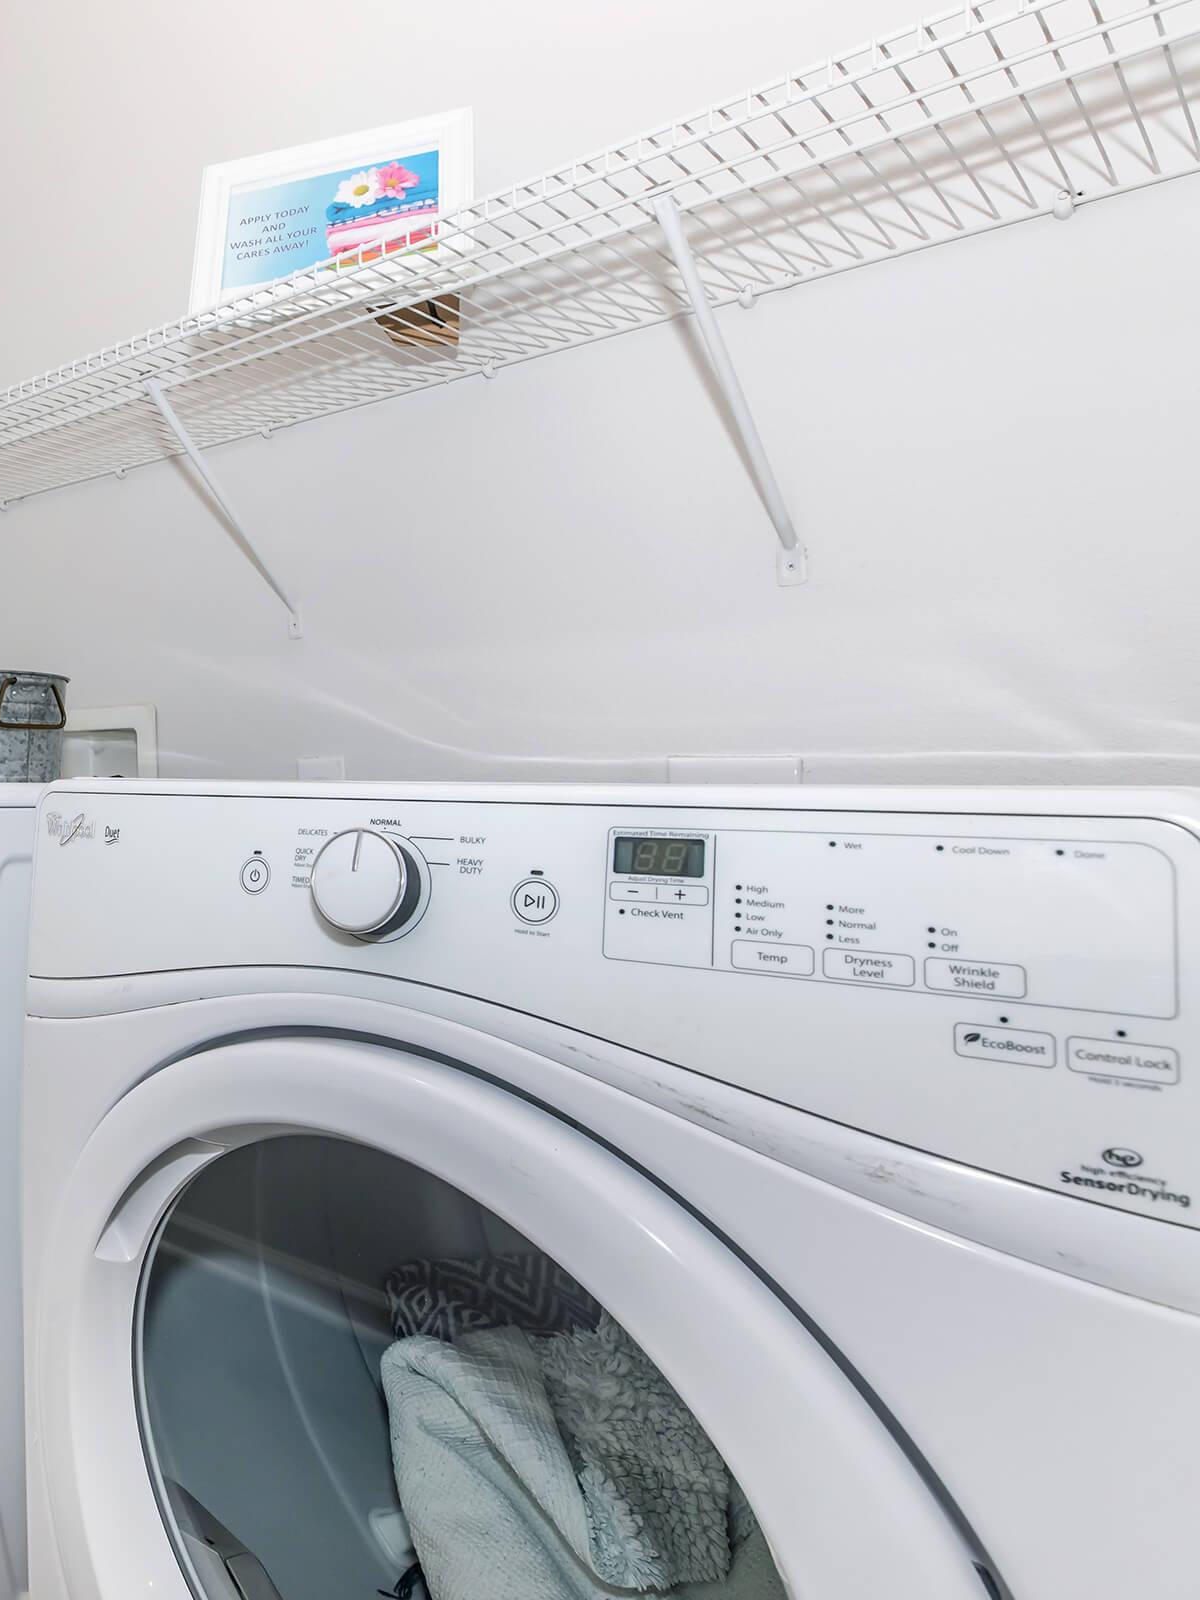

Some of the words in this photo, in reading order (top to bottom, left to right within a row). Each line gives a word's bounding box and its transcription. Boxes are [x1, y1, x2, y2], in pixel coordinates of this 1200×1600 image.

[240, 214, 271, 226] APPLY
[275, 205, 310, 220] TODAY
[262, 222, 286, 233] AND
[230, 238, 262, 250] WASH
[265, 234, 284, 244] ALL
[287, 226, 317, 239] YOUR
[236, 247, 270, 260] CARES
[273, 239, 309, 254] AWAY!
[369, 818, 402, 826] NORMAL
[104, 825, 120, 838] Duet
[298, 828, 329, 836] DELICATES
[613, 829, 648, 837] Estimated
[669, 831, 710, 840] Remaining
[460, 836, 486, 844] BULKY
[843, 841, 863, 850] Wet
[295, 847, 314, 855] QUICK
[951, 845, 976, 855] Cool
[978, 846, 1011, 855] Down
[457, 858, 484, 866] HEAVY
[459, 866, 483, 874] DUTY
[746, 885, 769, 894] High
[746, 898, 785, 909] Medium
[630, 907, 660, 918] Check
[661, 909, 684, 920] Vent
[838, 905, 865, 914] More
[746, 912, 765, 921] Low
[838, 919, 877, 930] Normal
[746, 927, 759, 935] Air
[761, 928, 784, 939] Only
[940, 927, 958, 937] On
[838, 935, 861, 945] Less
[940, 943, 959, 952] Off
[757, 951, 788, 964] Temp
[844, 954, 894, 969] Dryness
[852, 967, 885, 979] Level
[948, 964, 1001, 979] Wrinkle
[953, 977, 996, 991] Shield
[981, 1037, 1047, 1055] EcoBoost
[1075, 1048, 1132, 1066] Control
[1134, 1056, 1173, 1071] Lock
[1060, 1171, 1191, 1208] SensorDrying
